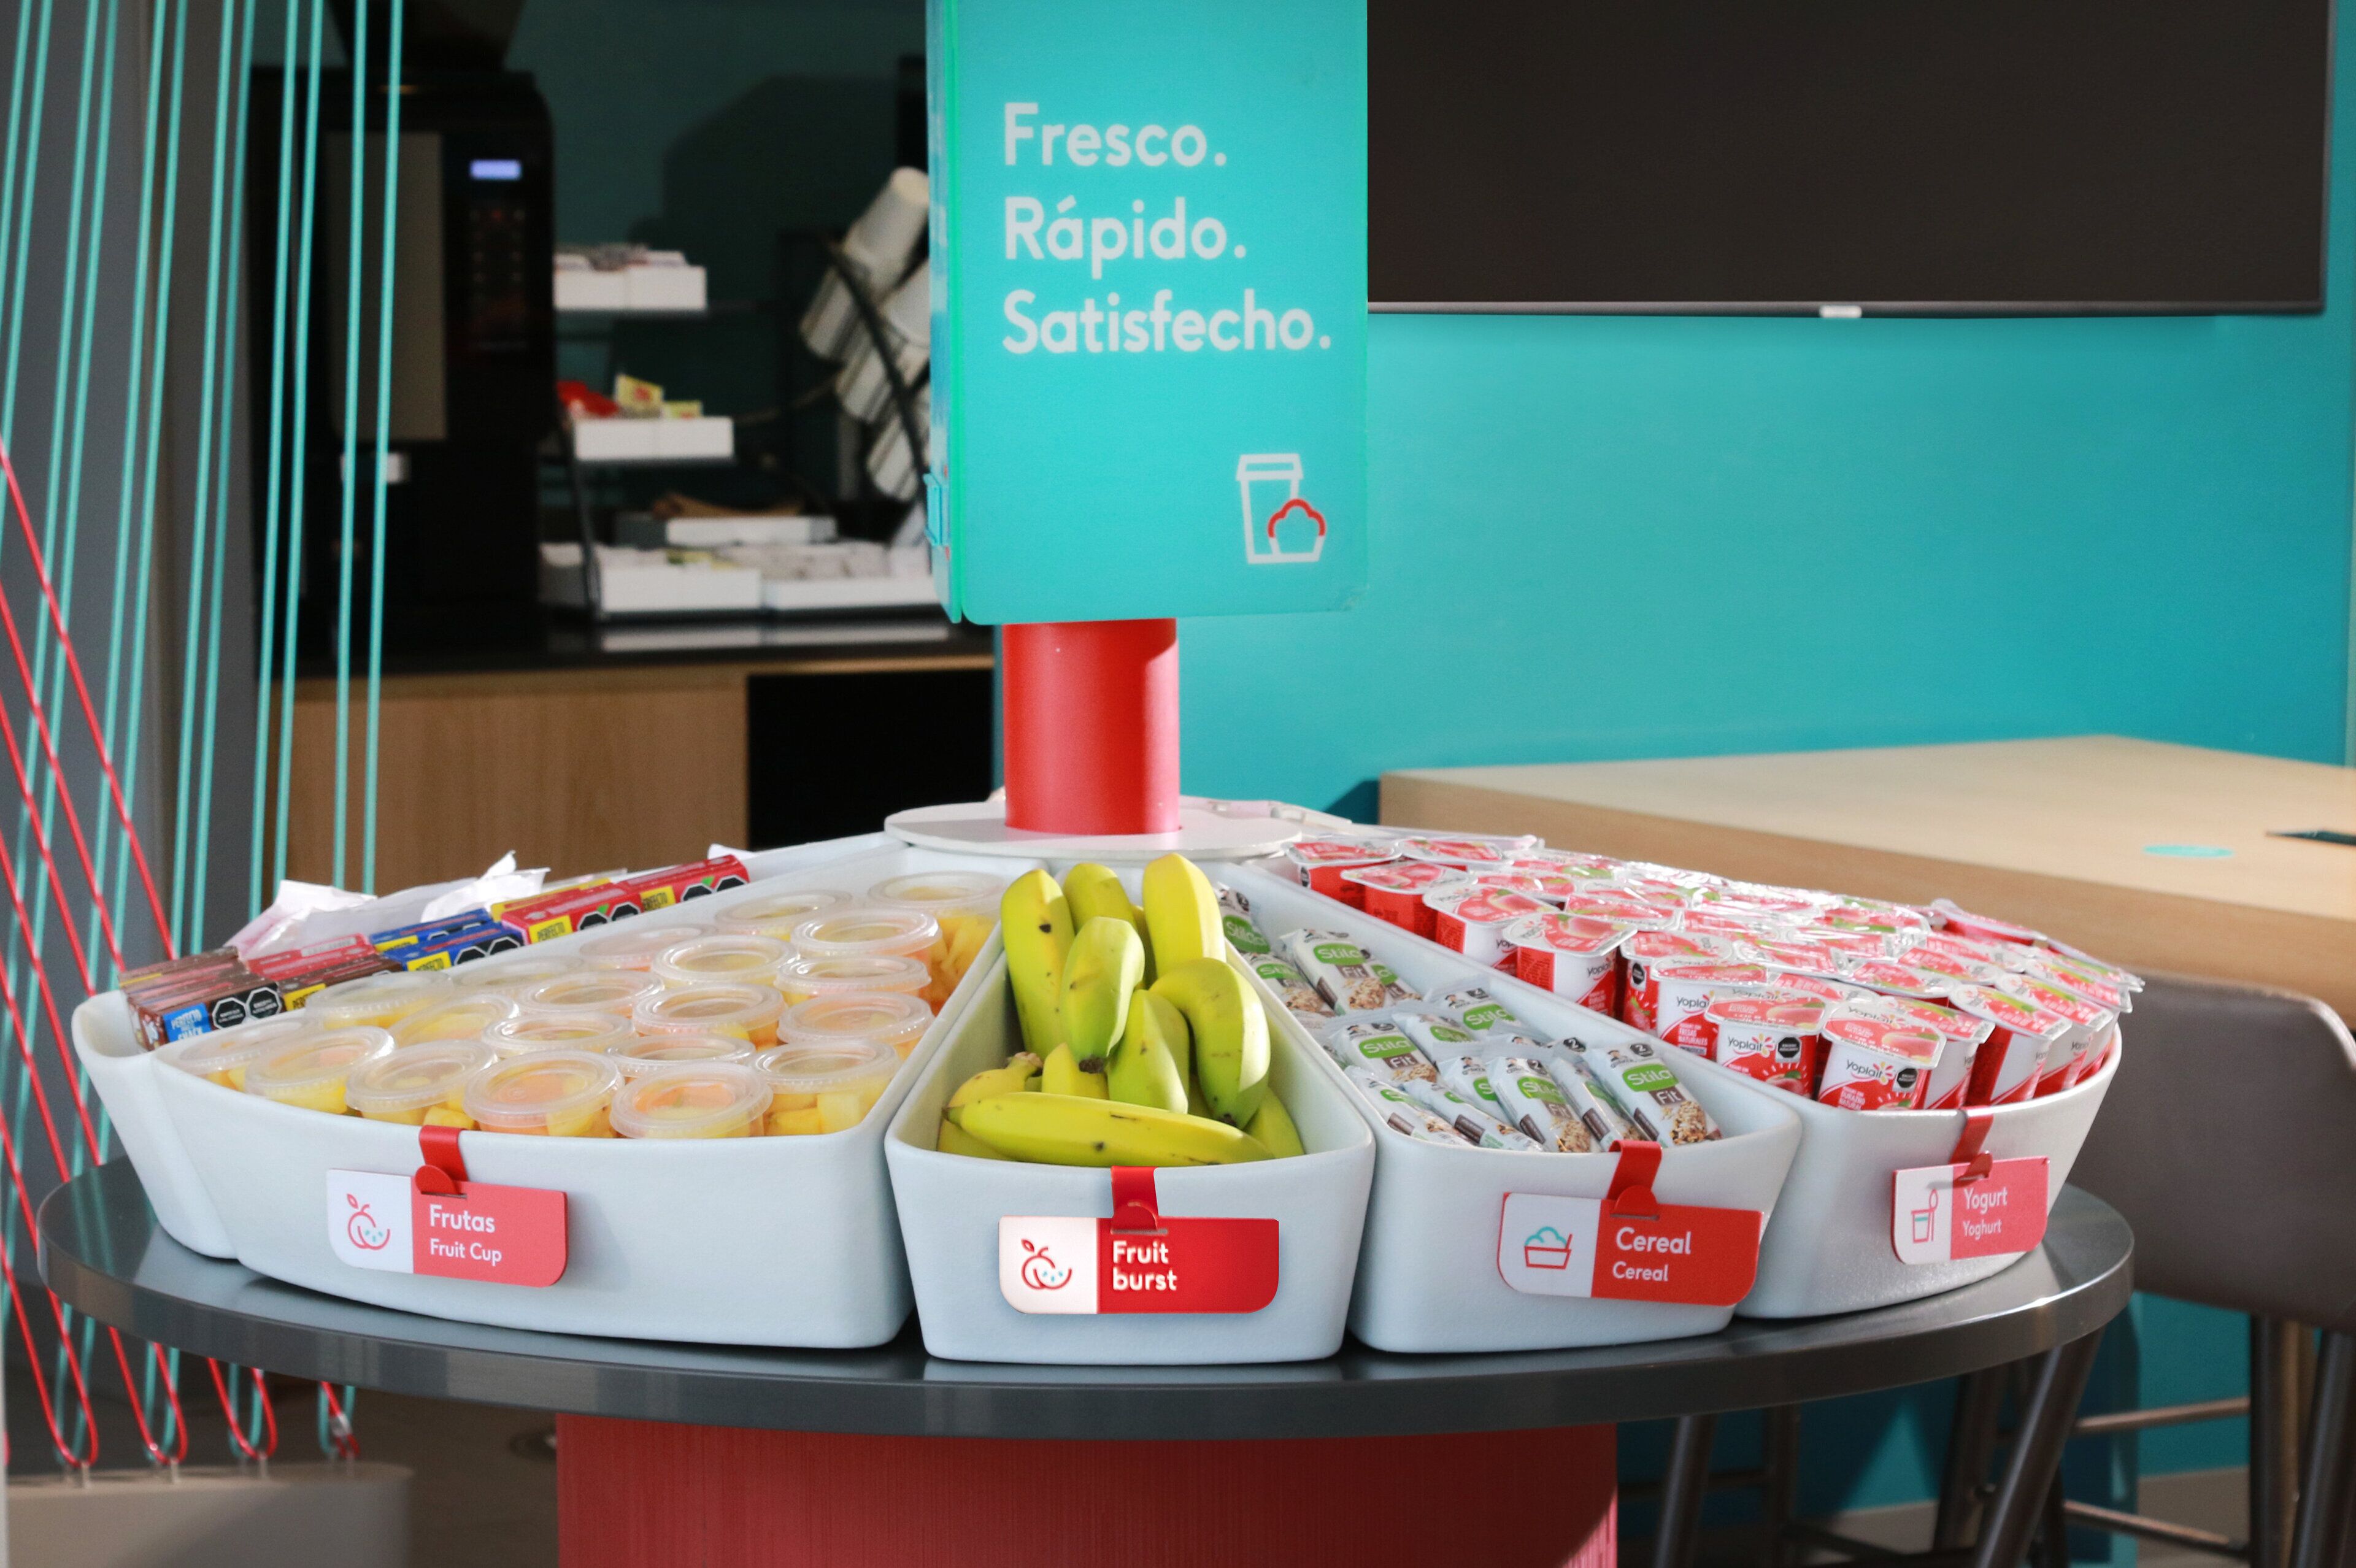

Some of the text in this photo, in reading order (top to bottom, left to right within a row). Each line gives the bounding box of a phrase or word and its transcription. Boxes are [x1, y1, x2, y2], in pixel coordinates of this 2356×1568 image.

[1004, 102, 1227, 167] Fresco.
[1004, 194, 1247, 280] Rápido.
[1002, 288, 1331, 354] Satisfecho.
[1390, 1057, 1417, 1069] Fit
[1627, 1069, 1673, 1086] Stila
[1658, 1091, 1682, 1104] Fit
[1964, 1187, 2008, 1215] Yogurt
[429, 1204, 496, 1233] Frutas
[1963, 1219, 2002, 1240] Yoghurt
[430, 1238, 502, 1266] Fruit Cup
[1112, 1240, 1169, 1264] Fruit
[1615, 1227, 1692, 1255] Cereal
[1112, 1267, 1177, 1291] burst
[1612, 1261, 1669, 1282] Cereal
